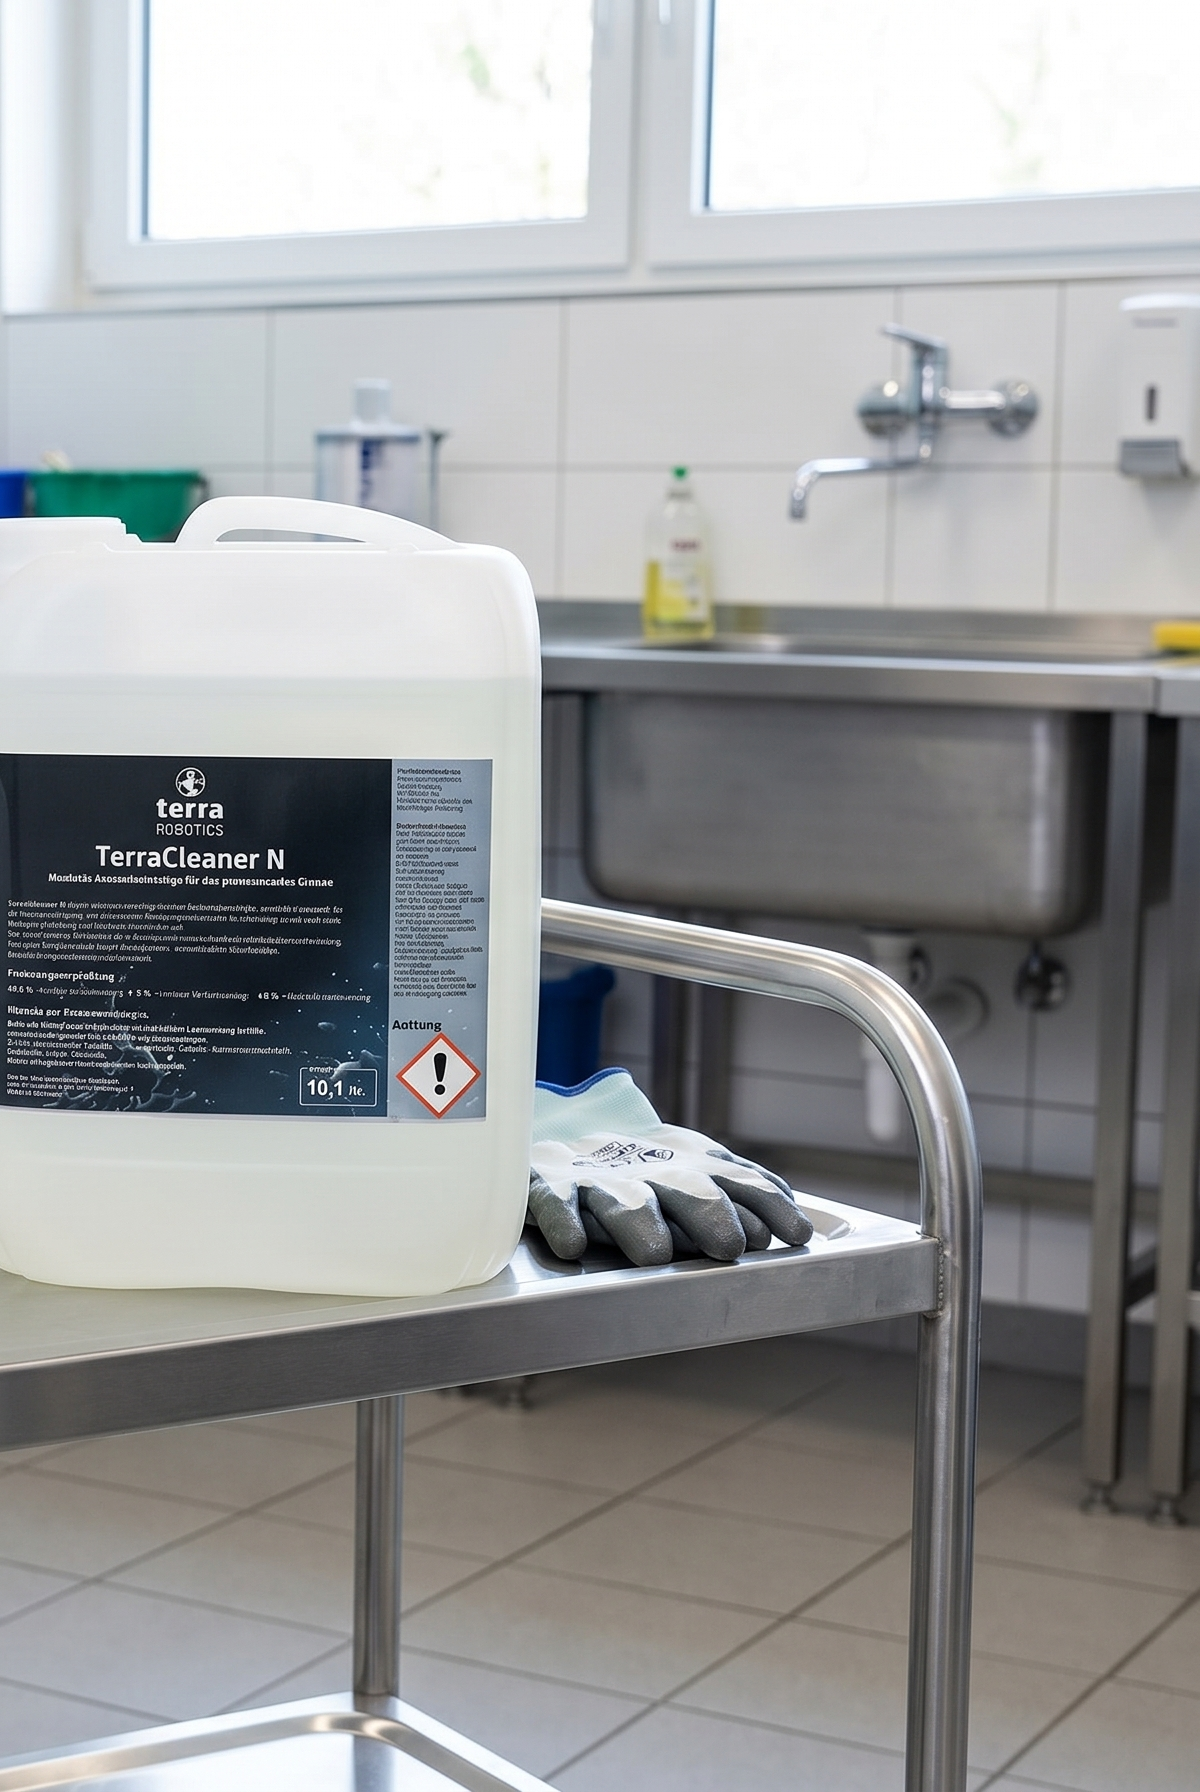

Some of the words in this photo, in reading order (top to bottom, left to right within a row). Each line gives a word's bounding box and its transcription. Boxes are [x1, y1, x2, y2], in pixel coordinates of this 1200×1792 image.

[156, 798, 224, 820] terra
[156, 824, 224, 836] ROBOTICS
[95, 845, 260, 870] TerraCleaner
[266, 848, 285, 870] N
[184, 874, 199, 885] für
[202, 876, 220, 886] das
[307, 1078, 343, 1100] 10,1
